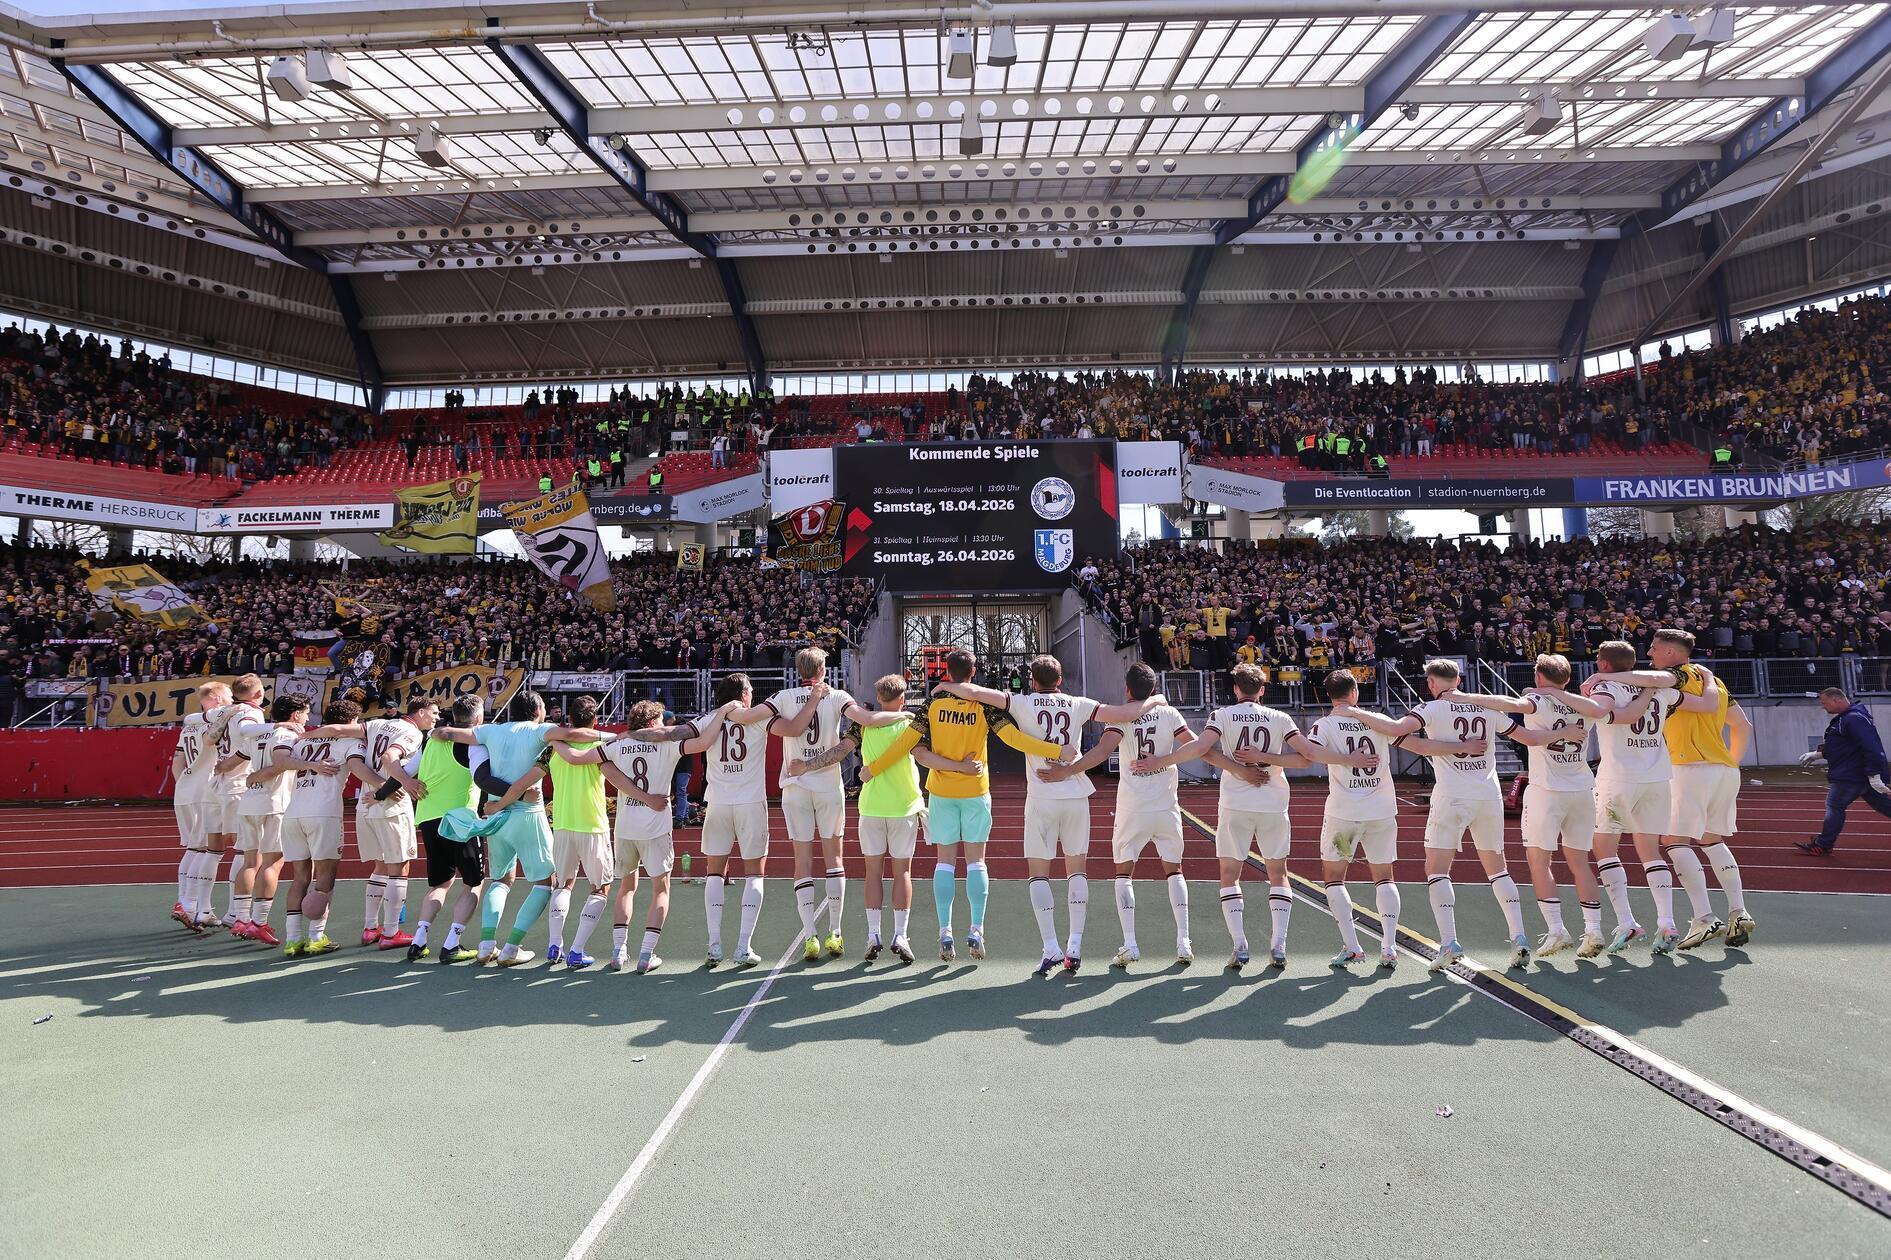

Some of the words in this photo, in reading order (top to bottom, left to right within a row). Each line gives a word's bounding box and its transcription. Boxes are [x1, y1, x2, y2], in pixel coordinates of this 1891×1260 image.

[910, 447, 991, 461] Kommende
[994, 445, 1040, 462] Spiele
[1121, 466, 1178, 478] toolcraft
[774, 474, 832, 486] toolcraft
[1605, 479, 1714, 498] FRANKEN
[1722, 468, 1851, 497] BRUNNEN
[723, 489, 750, 500] MORLOCK
[885, 487, 914, 495] Spieltag
[924, 485, 974, 494] Auswärtsspiel
[1217, 488, 1242, 498] STADION
[1219, 482, 1231, 490] MAX
[1232, 485, 1262, 497] MORLOCK
[1315, 488, 1334, 498] Die
[1336, 487, 1411, 498] Eventlocation
[1428, 486, 1545, 499] stadion-nuernberg.de
[15, 493, 94, 511] THERME
[100, 503, 186, 521] HERSBRUCK
[712, 498, 736, 508] STADION
[874, 501, 936, 515] Samstag,
[939, 500, 1016, 512] 18.04.2026
[238, 511, 321, 522] FACKELMANN
[330, 510, 380, 520] THERME
[873, 536, 883, 544] 31.
[884, 536, 912, 544] Spieltag
[922, 535, 959, 544] Heimspiel
[874, 550, 935, 565] Sonntag,
[938, 550, 1016, 562] 26.04.2026
[1037, 548, 1072, 571] MAGDEBURG
[1034, 698, 1072, 707] DRESDEN
[1232, 713, 1270, 722] DRESDEN
[807, 710, 820, 745] 9
[1037, 710, 1070, 745] 23
[719, 723, 747, 762] 13
[1135, 725, 1157, 760] 15
[1453, 716, 1487, 758] 32
[621, 744, 658, 755] DRESDEN
[1346, 736, 1377, 777] 10
[632, 757, 649, 793] 8
[723, 764, 744, 773] PAULI
